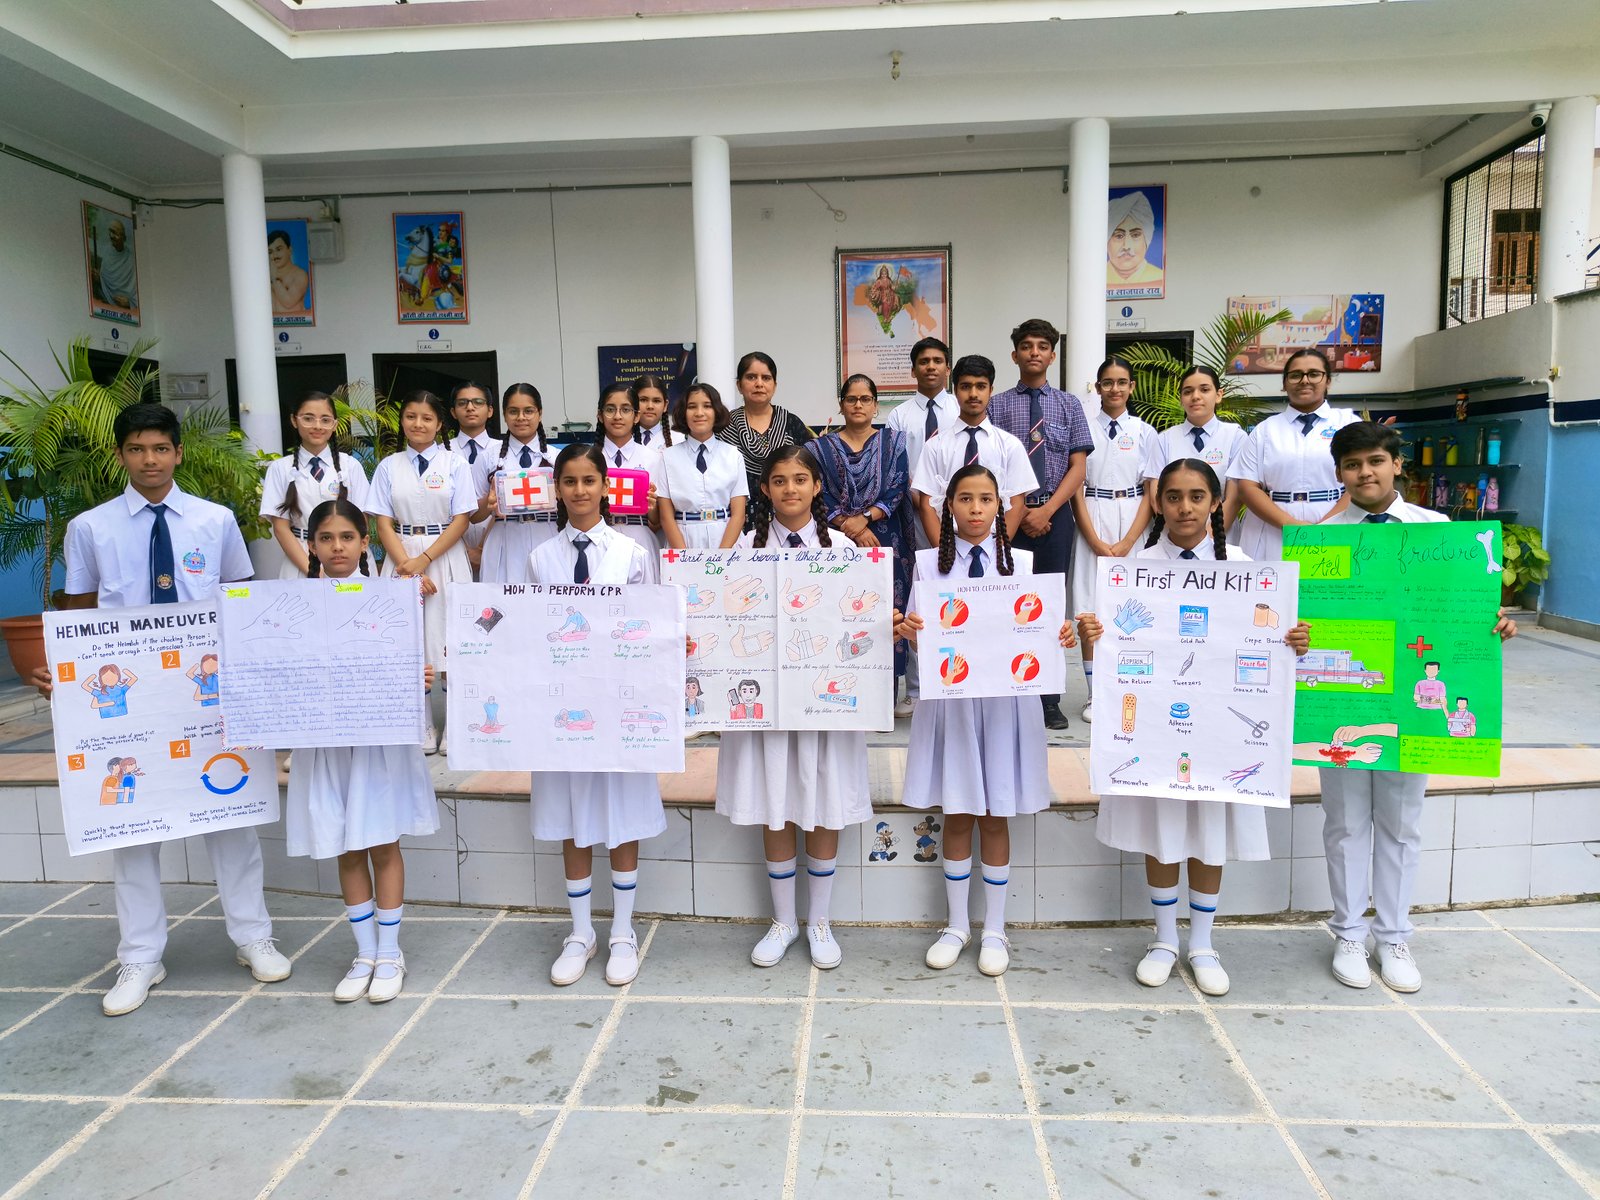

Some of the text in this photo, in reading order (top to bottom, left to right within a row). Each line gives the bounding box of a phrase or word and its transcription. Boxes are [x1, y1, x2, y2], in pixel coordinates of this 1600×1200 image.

[1116, 288, 1144, 296] लाजपत
[1147, 287, 1160, 295] राय
[621, 365, 660, 373] confidence
[1285, 526, 1328, 557] First
[680, 549, 704, 563] First
[706, 553, 723, 563] aid
[726, 551, 741, 566] for
[747, 550, 780, 562] burns
[795, 550, 822, 562] What
[824, 549, 837, 562] to
[842, 547, 862, 562] Do
[1351, 529, 1479, 576] for fracture
[705, 562, 724, 575] Do
[808, 561, 850, 574] Do not
[1310, 554, 1342, 577] Aid
[1135, 568, 1252, 593] First Aid Kit
[503, 585, 622, 596] HOW TO PERFORM CPR
[982, 584, 1001, 592] CLEAN
[56, 611, 217, 639] HEIMLICH MANEUVER
[1244, 636, 1262, 646] Crepe
[156, 644, 184, 652] conscious
[167, 653, 177, 667] 2
[62, 664, 71, 679] 1
[175, 743, 187, 756] 4
[1401, 739, 1409, 747] 5
[71, 757, 83, 769] 3
[1197, 784, 1215, 792] Bottle
[84, 827, 106, 836] Quickly
